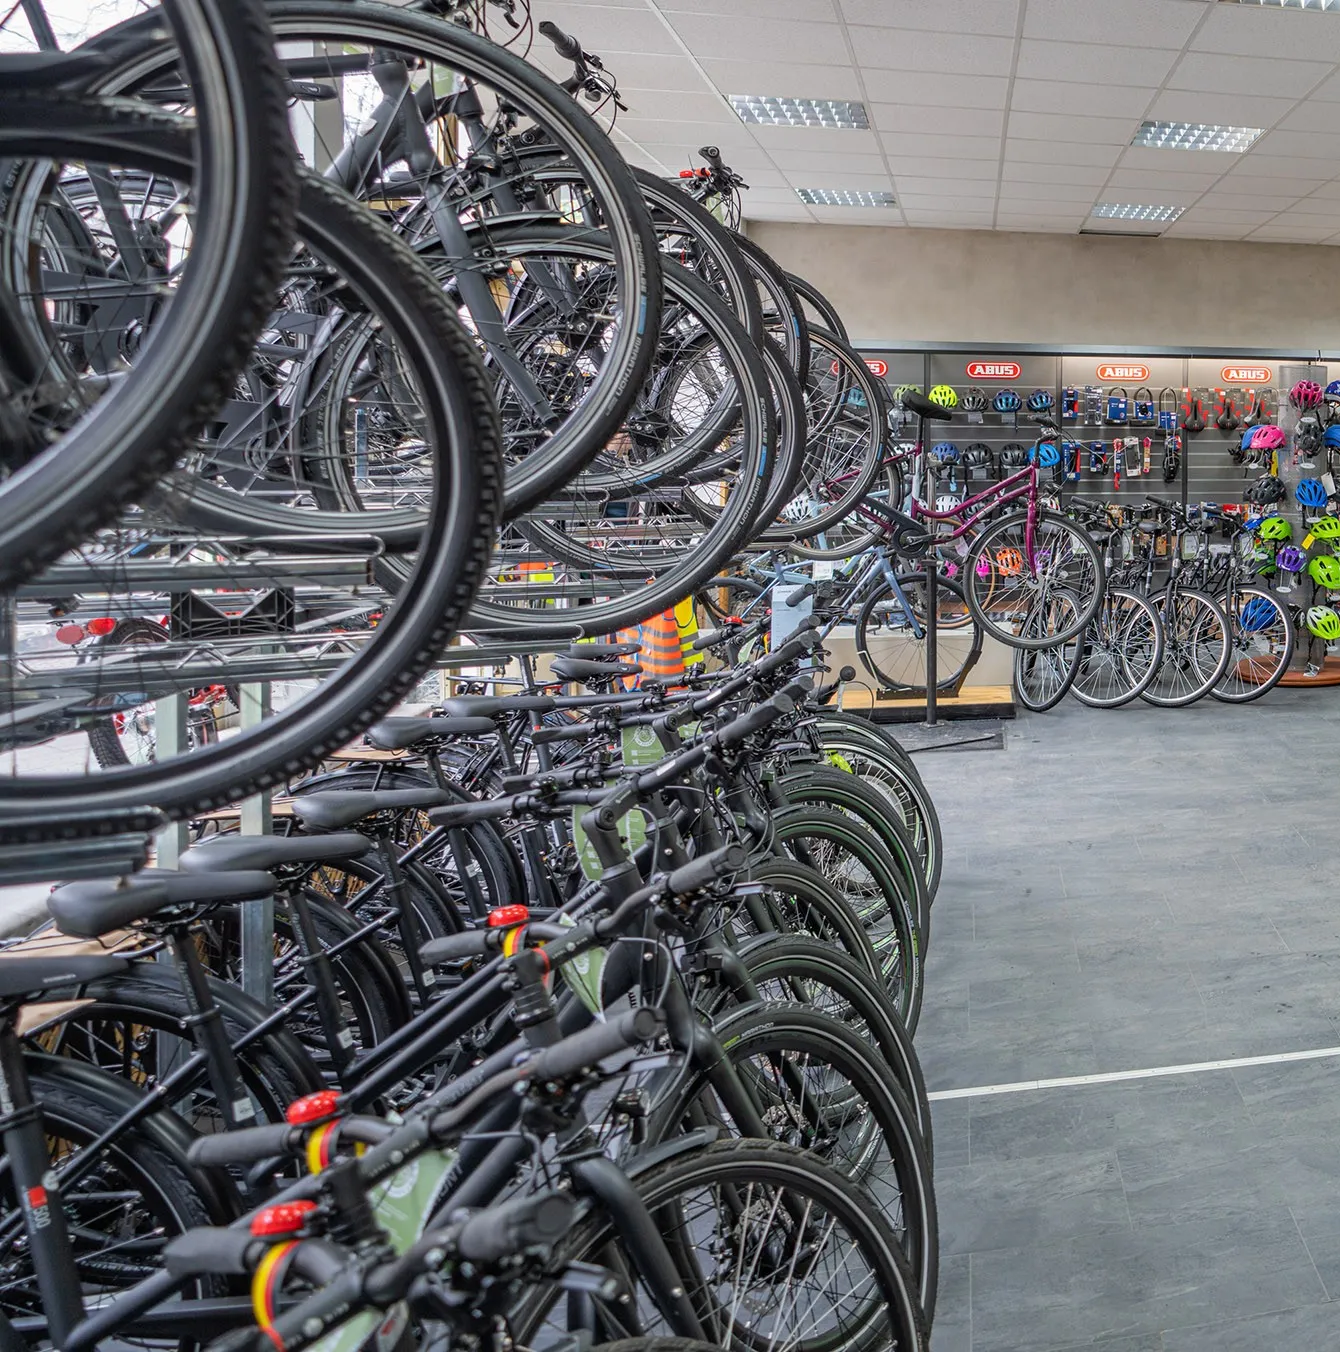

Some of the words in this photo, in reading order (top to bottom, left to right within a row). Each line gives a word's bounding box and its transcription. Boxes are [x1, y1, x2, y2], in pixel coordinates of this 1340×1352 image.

[974, 365, 1014, 375] ABUS
[1104, 367, 1142, 378] ABUS
[1228, 369, 1264, 380] ABUS
